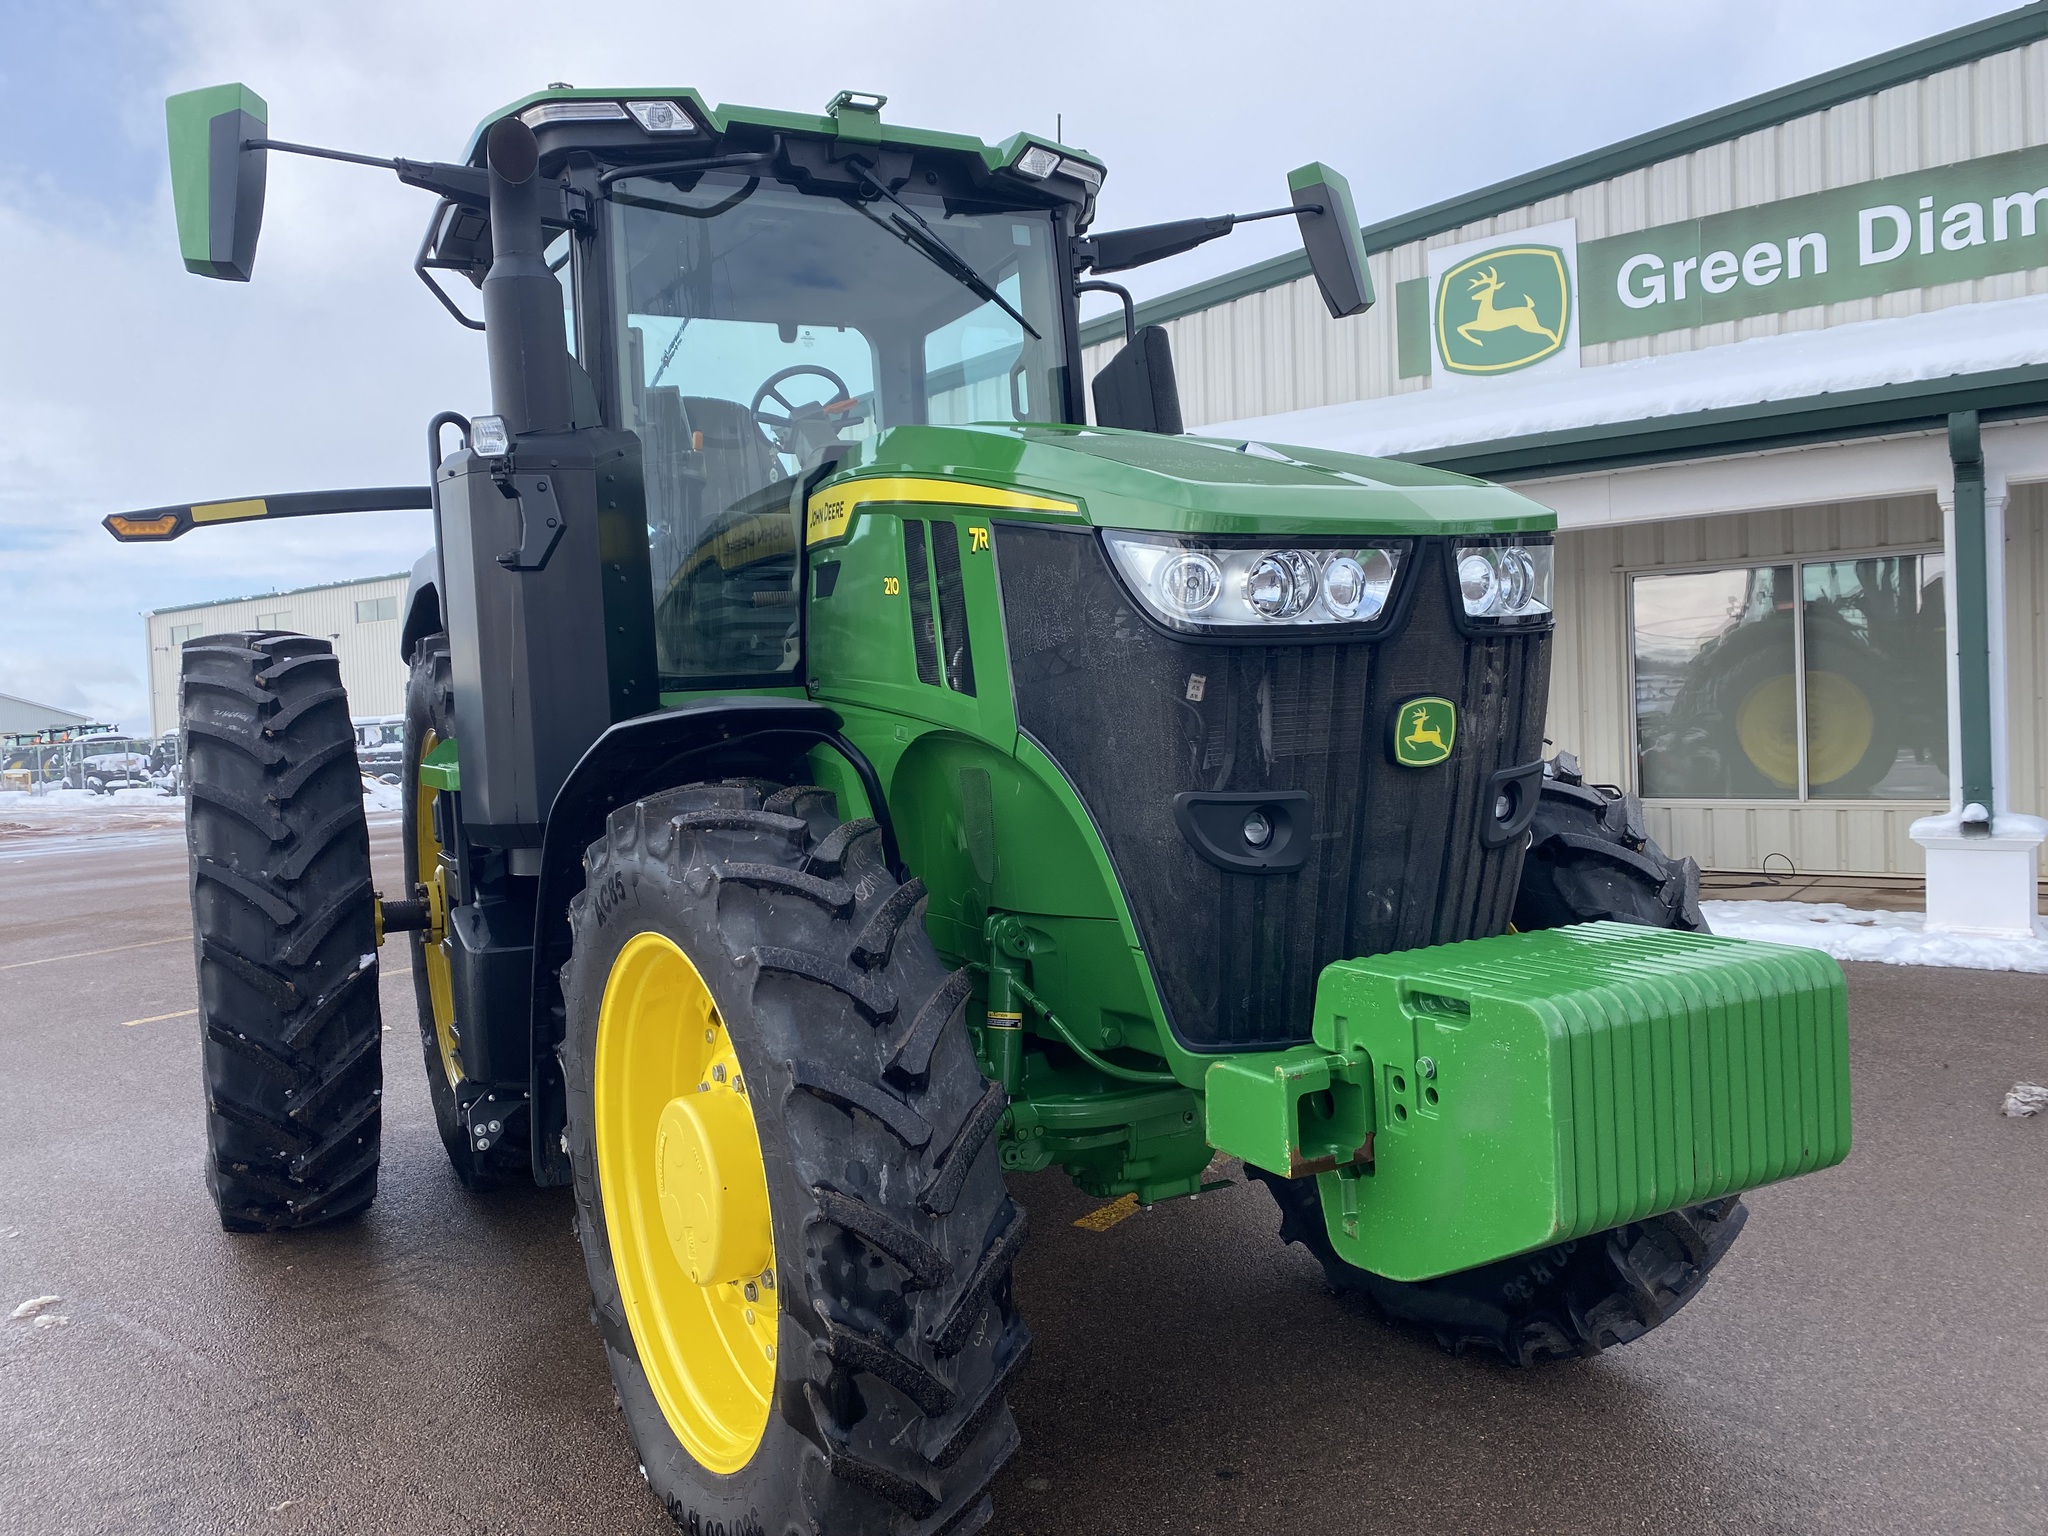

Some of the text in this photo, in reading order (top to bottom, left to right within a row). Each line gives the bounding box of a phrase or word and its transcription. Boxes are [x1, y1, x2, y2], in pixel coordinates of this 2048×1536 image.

[1616, 186, 2048, 309] Green Diam
[809, 501, 845, 529] JOHN DEERE
[968, 527, 989, 554] 7R
[884, 577, 899, 596] 210
[594, 870, 627, 928] AC85
